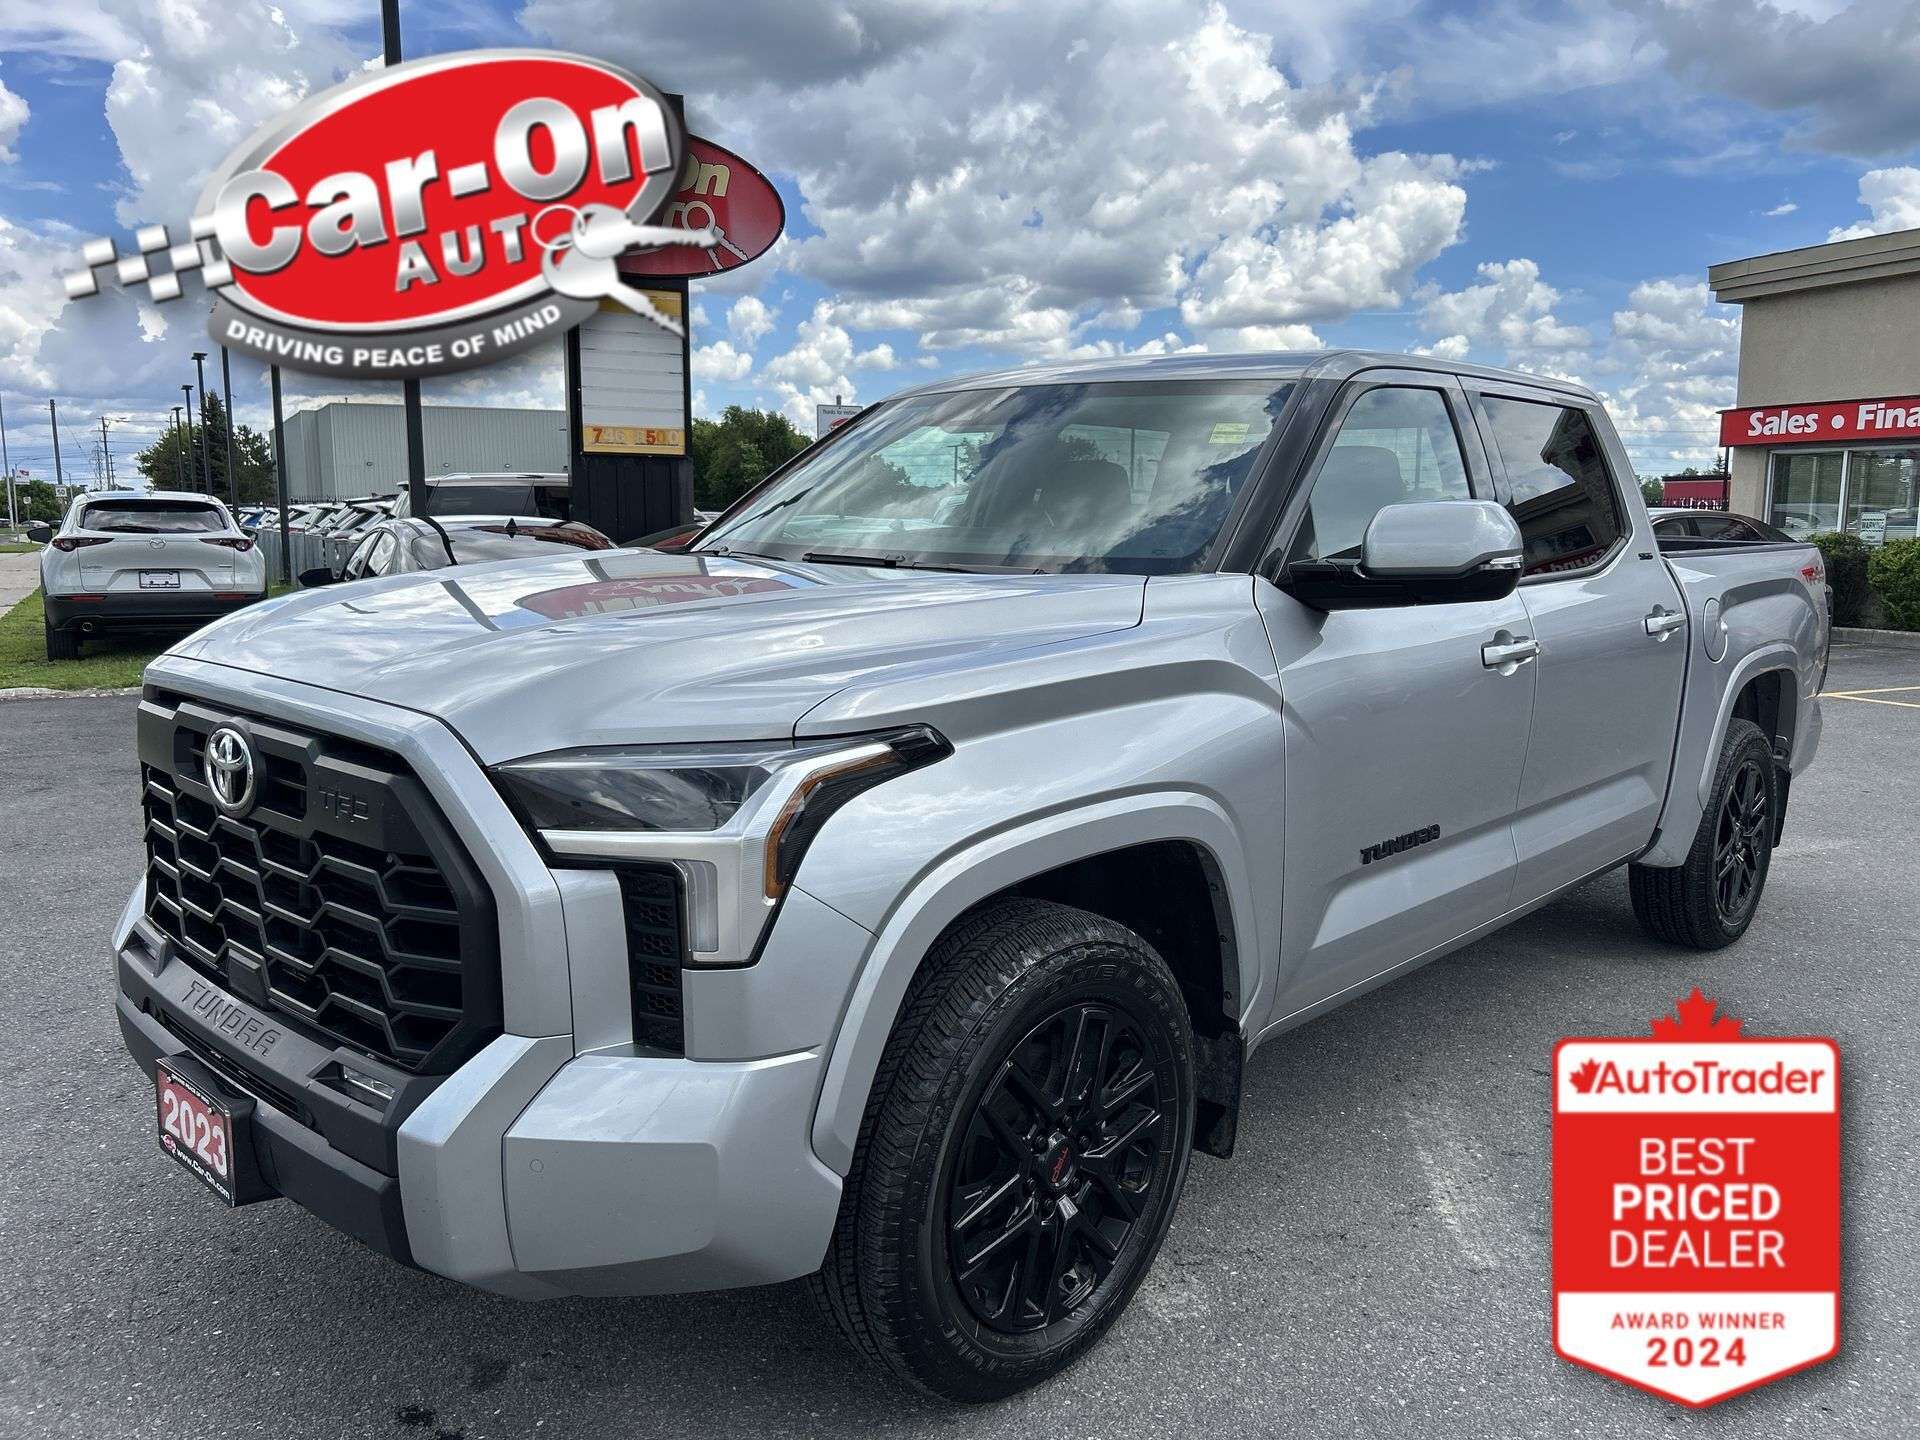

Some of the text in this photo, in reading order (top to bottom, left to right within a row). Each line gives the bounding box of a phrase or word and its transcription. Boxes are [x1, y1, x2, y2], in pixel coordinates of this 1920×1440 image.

[1747, 409, 1819, 437] Sales
[1360, 823, 1441, 865] TUNDRA
[181, 980, 281, 1056] TUNDRA
[163, 1088, 227, 1177] 2023
